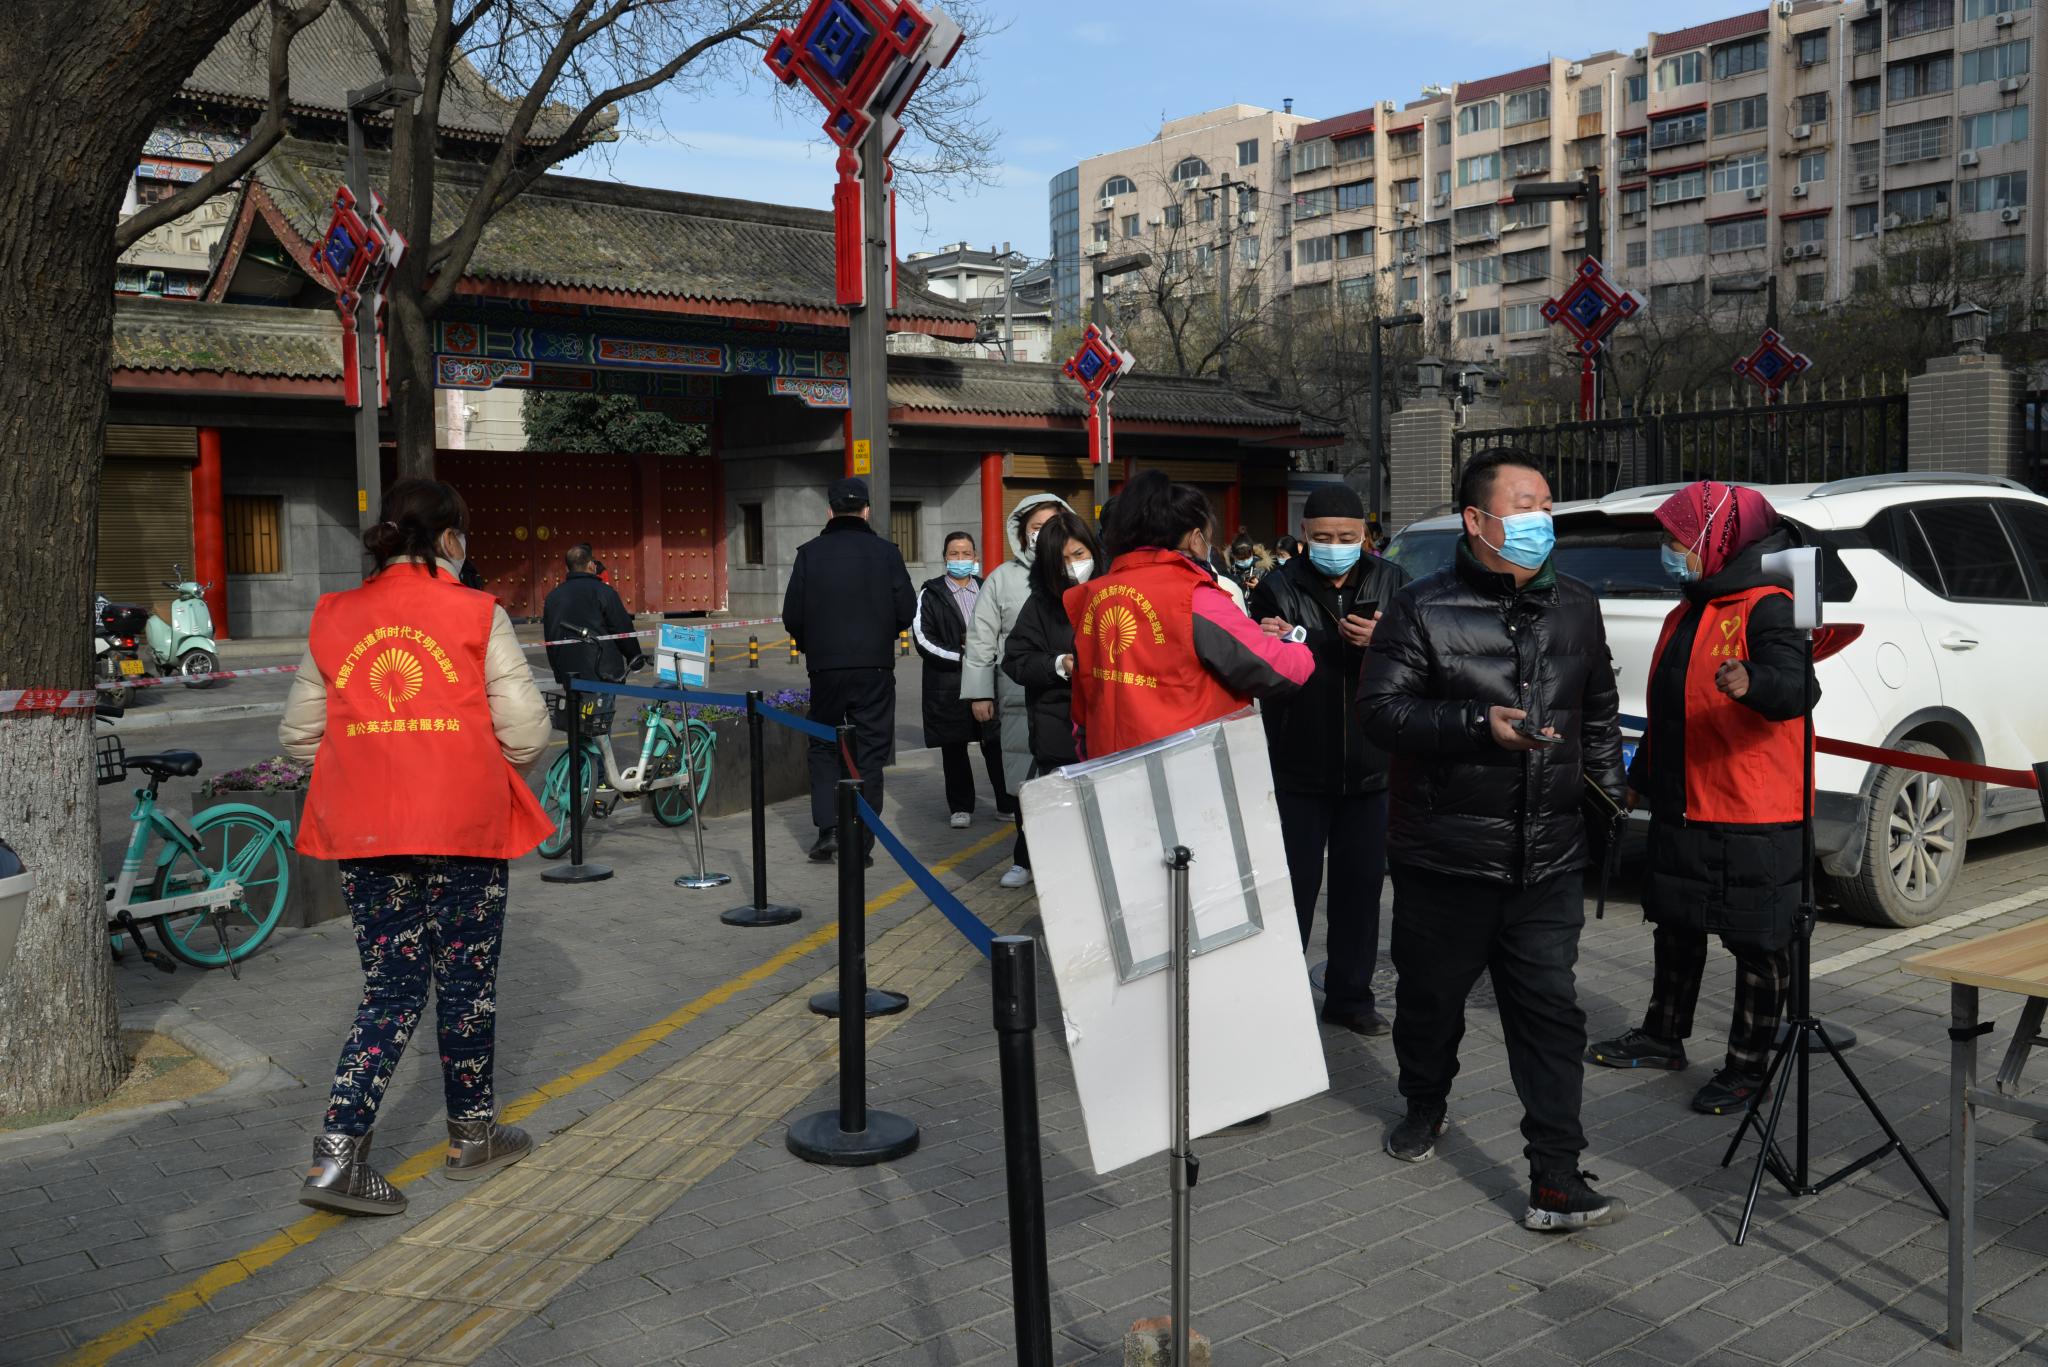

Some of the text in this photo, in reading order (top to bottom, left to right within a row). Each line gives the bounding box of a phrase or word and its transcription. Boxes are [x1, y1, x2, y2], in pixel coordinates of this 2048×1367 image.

[335, 625, 459, 689] 南院门街道新时代文明实践所
[346, 718, 460, 737] 蒲公英志愿者服务站
